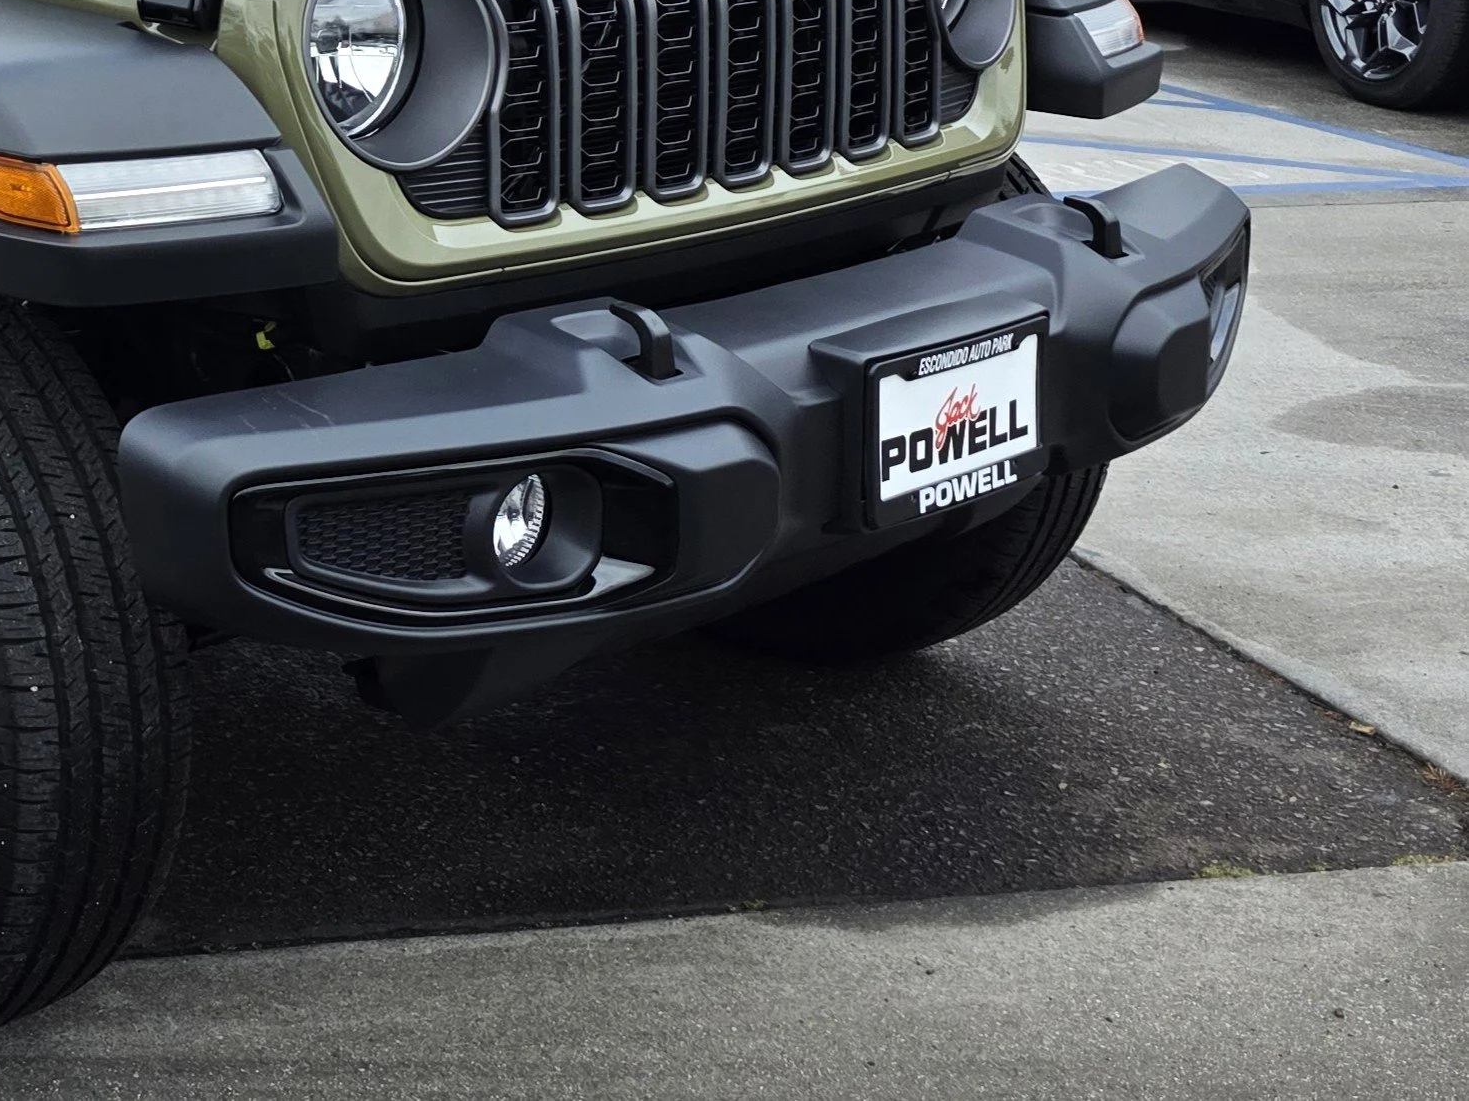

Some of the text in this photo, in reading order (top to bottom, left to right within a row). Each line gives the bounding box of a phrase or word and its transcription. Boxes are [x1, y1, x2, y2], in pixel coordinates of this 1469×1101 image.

[918, 332, 1014, 376] ESCONDIDO AUTO PARK
[881, 399, 1029, 483] POWELL
[935, 383, 980, 450] Jack
[919, 459, 1018, 514] POWELL
